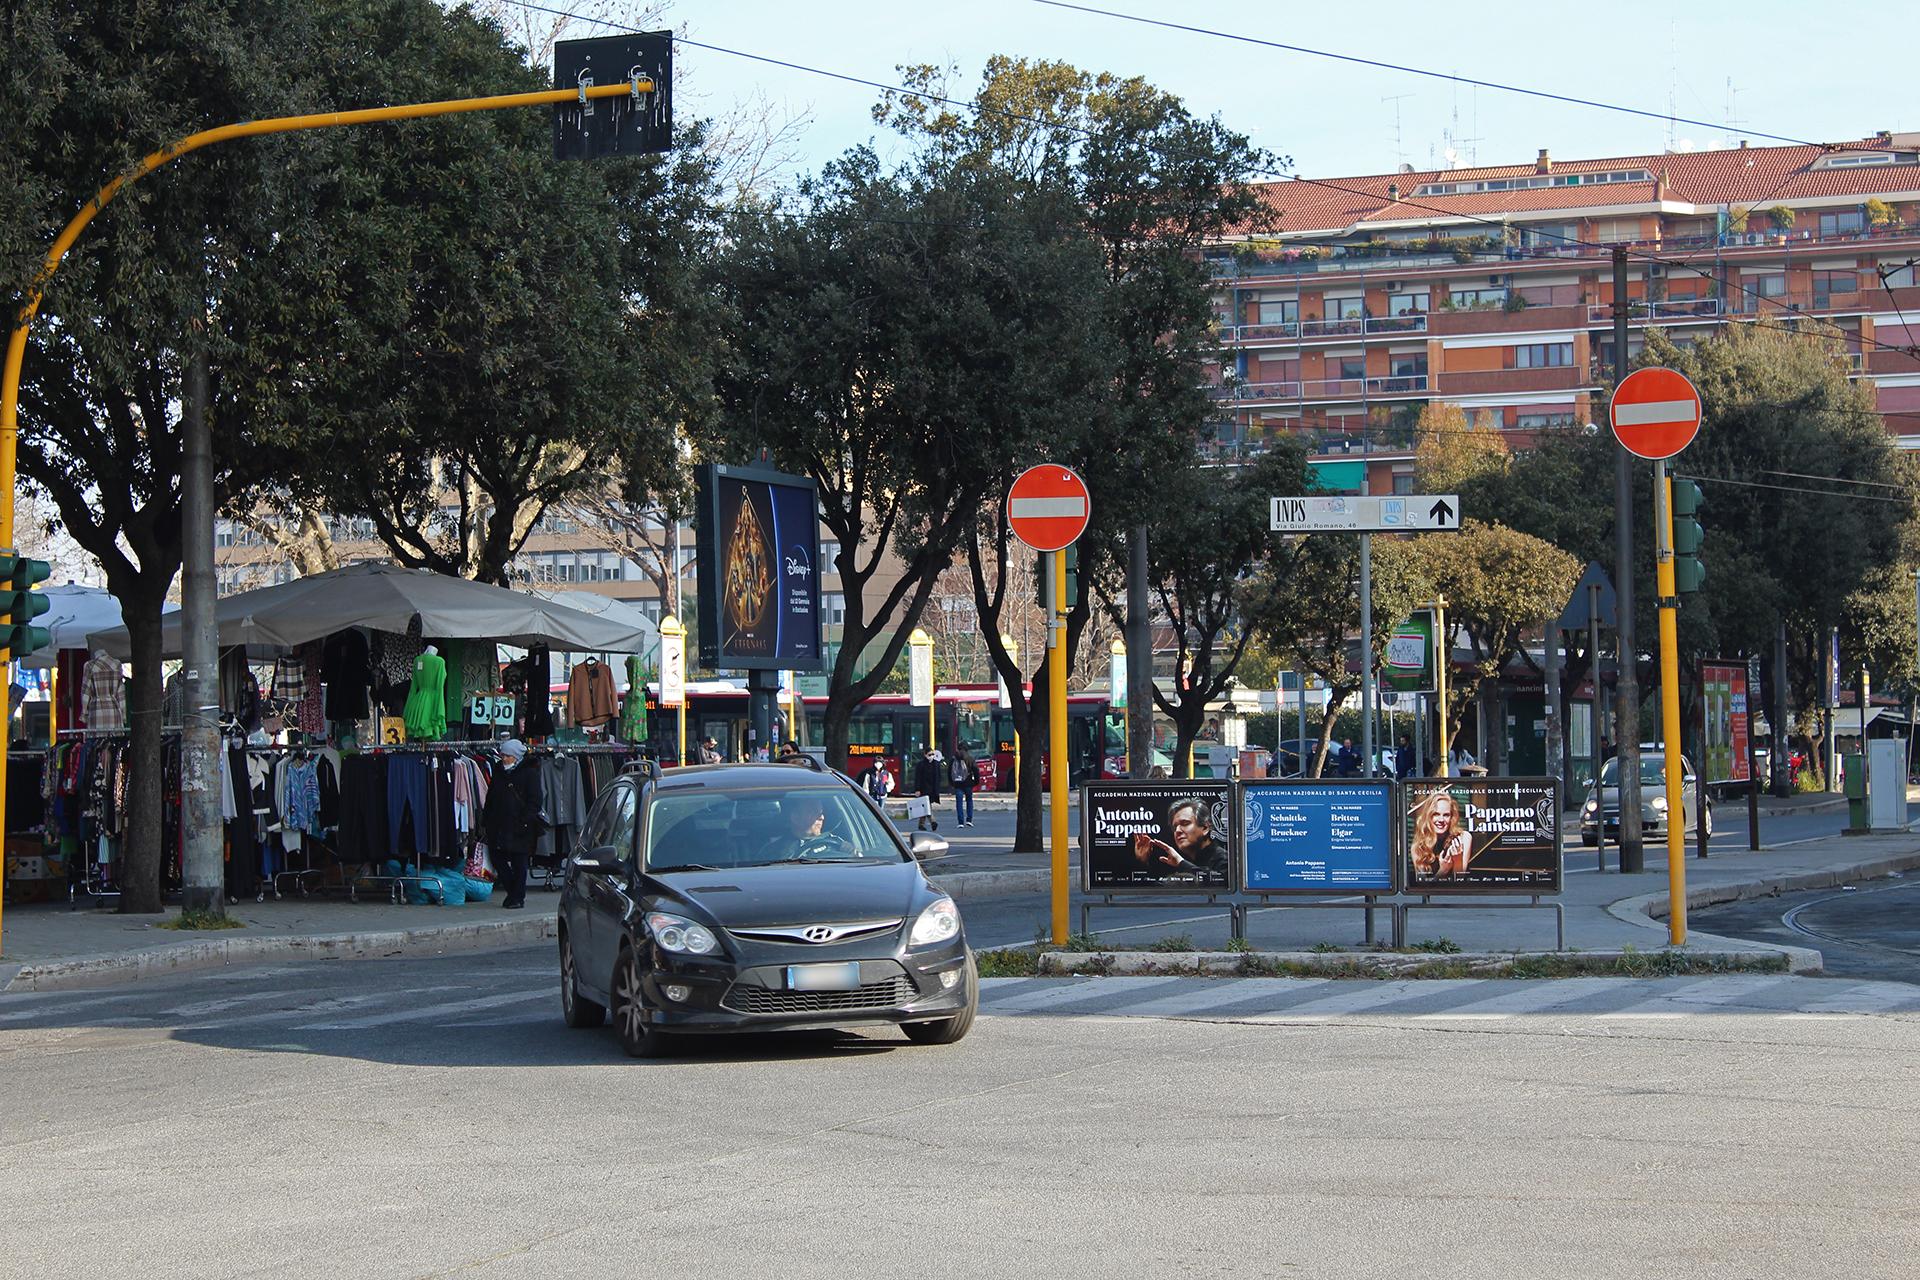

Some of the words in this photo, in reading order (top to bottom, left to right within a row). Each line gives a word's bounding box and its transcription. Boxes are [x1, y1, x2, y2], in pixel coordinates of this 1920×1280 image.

[1276, 500, 1306, 522] INPS
[1385, 501, 1402, 513] INPS
[474, 696, 513, 721] 5,00
[1095, 807, 1153, 820] Antonio
[1270, 814, 1307, 822] Schnittke
[1465, 804, 1534, 822] Pappano
[1095, 820, 1161, 838] Pappano
[1468, 818, 1534, 832] Lamsma
[1331, 828, 1352, 837] Elgar
